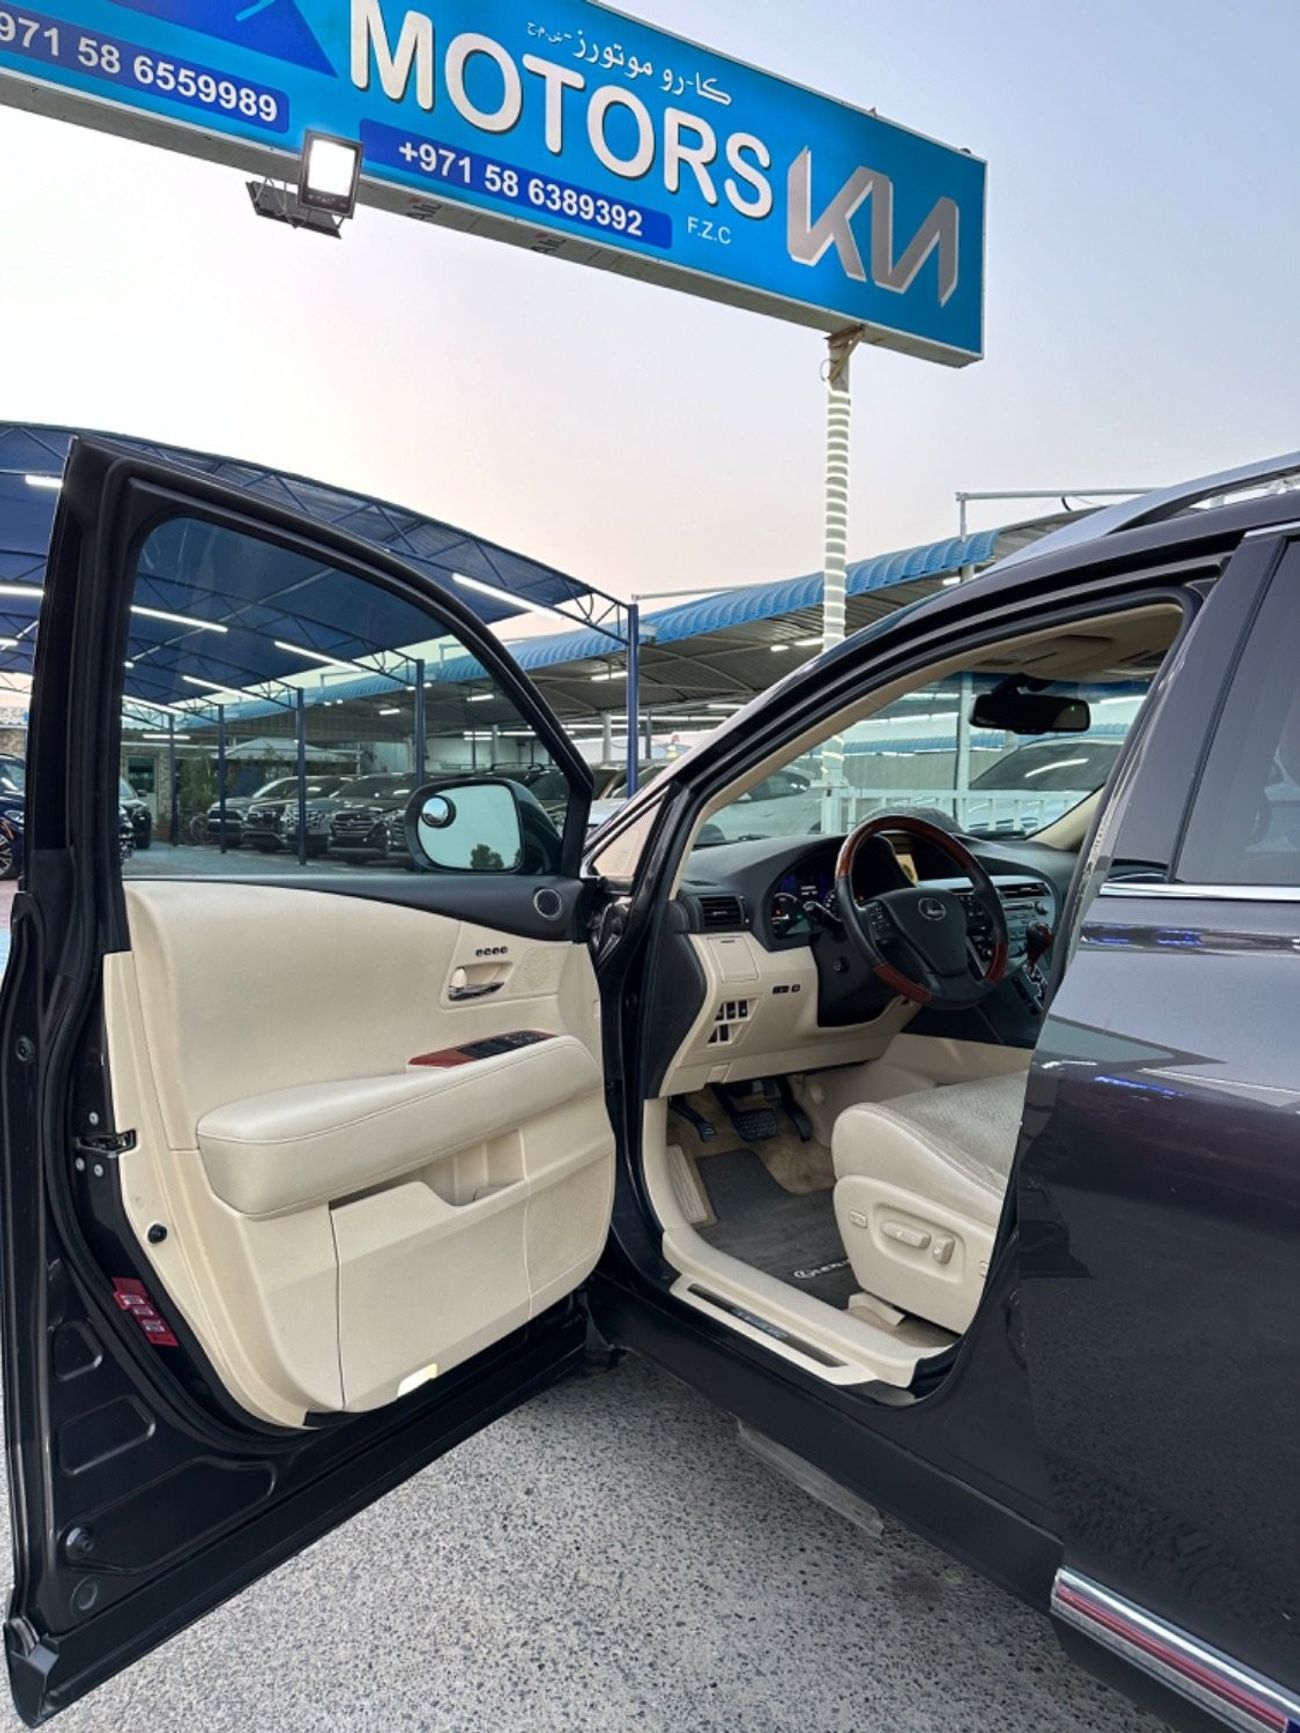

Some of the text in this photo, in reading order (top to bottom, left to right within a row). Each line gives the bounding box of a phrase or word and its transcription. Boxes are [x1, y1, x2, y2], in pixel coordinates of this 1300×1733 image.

[78, 36, 121, 74] 58
[133, 55, 278, 122] 6559989
[572, 29, 653, 79] موتورز
[350, 0, 773, 219] MOTORS
[398, 141, 643, 237] +971 58 6389392
[687, 216, 733, 245] F.Z.C
